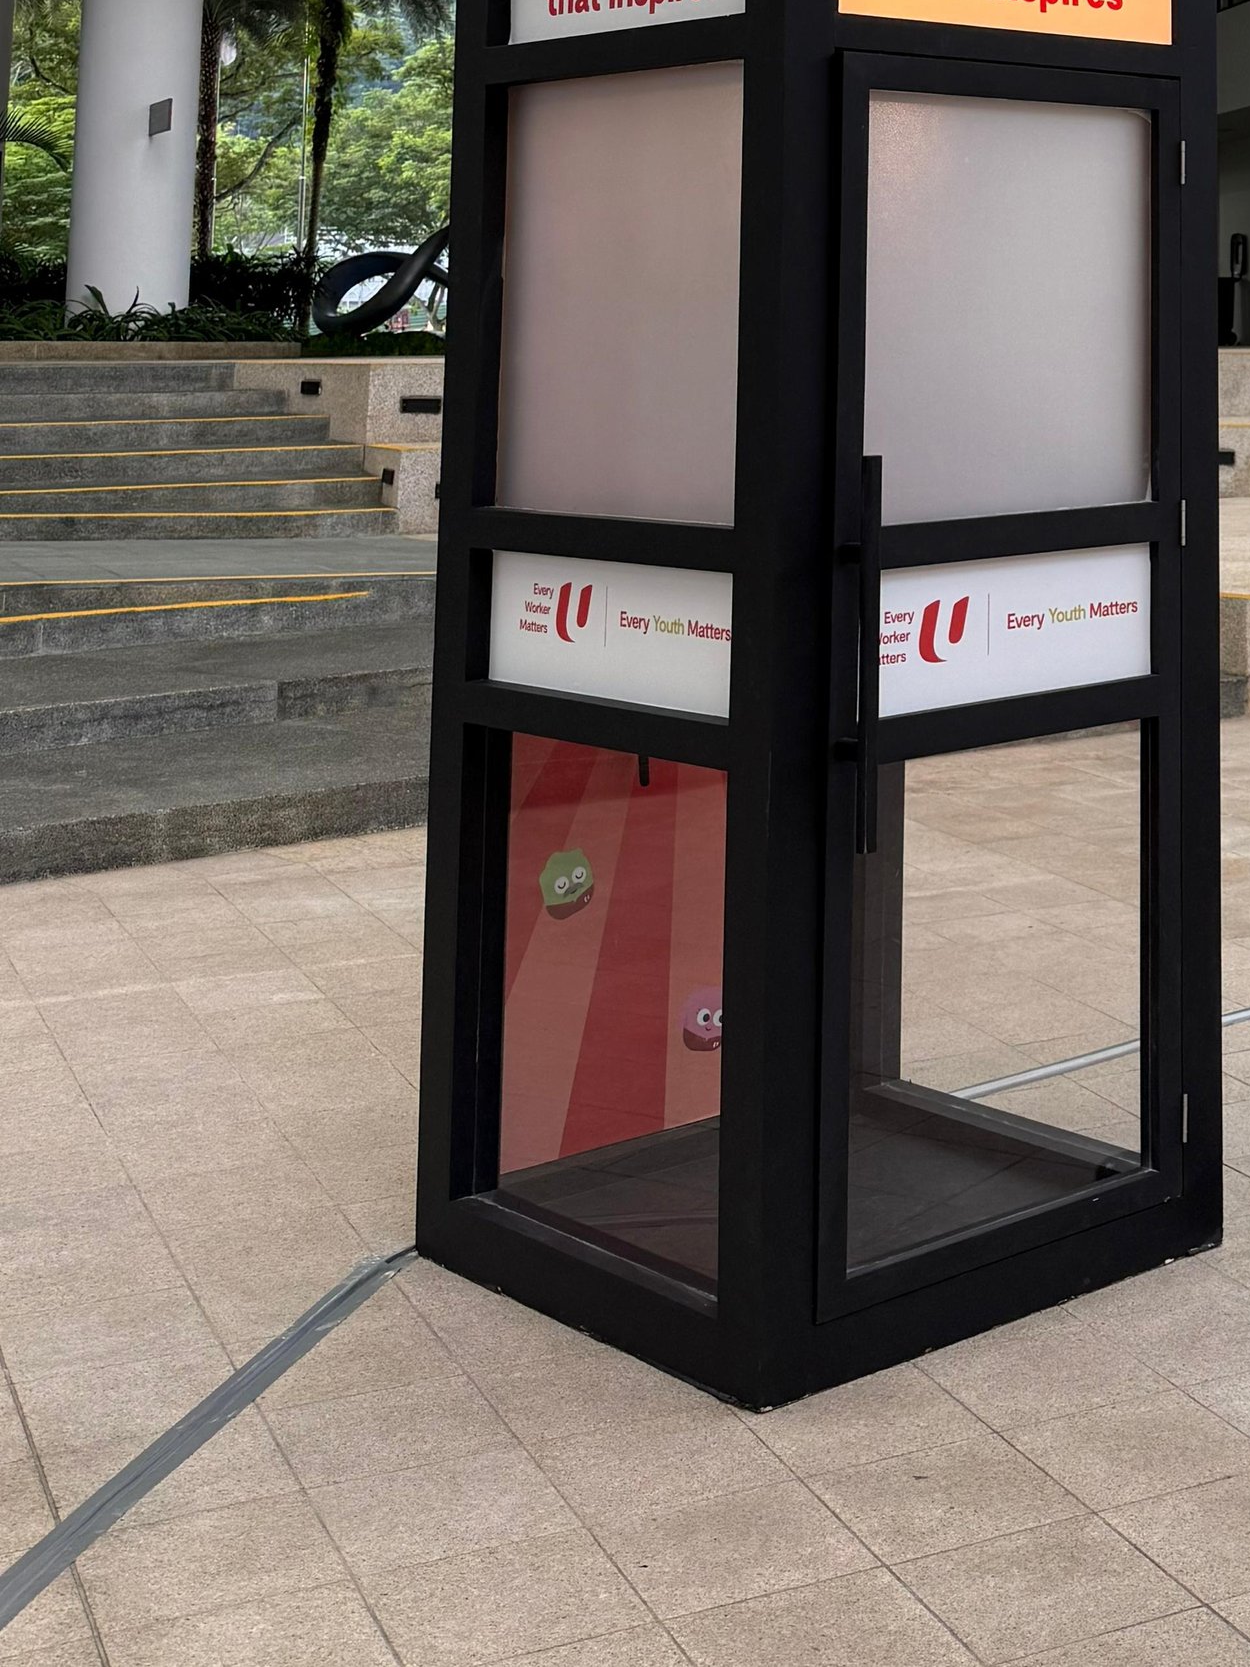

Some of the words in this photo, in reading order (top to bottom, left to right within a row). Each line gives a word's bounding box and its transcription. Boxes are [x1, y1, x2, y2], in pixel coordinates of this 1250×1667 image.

[533, 583, 554, 599] Every
[524, 600, 551, 615] Worker
[1006, 611, 1045, 630] Every
[1049, 604, 1086, 624] Youth
[1089, 600, 1138, 619] Matters
[519, 618, 548, 634] Matters
[619, 610, 650, 634] Every
[653, 615, 685, 635] Youth
[687, 619, 732, 642] Matters
[884, 610, 915, 626] Every
[880, 630, 911, 645] orker
